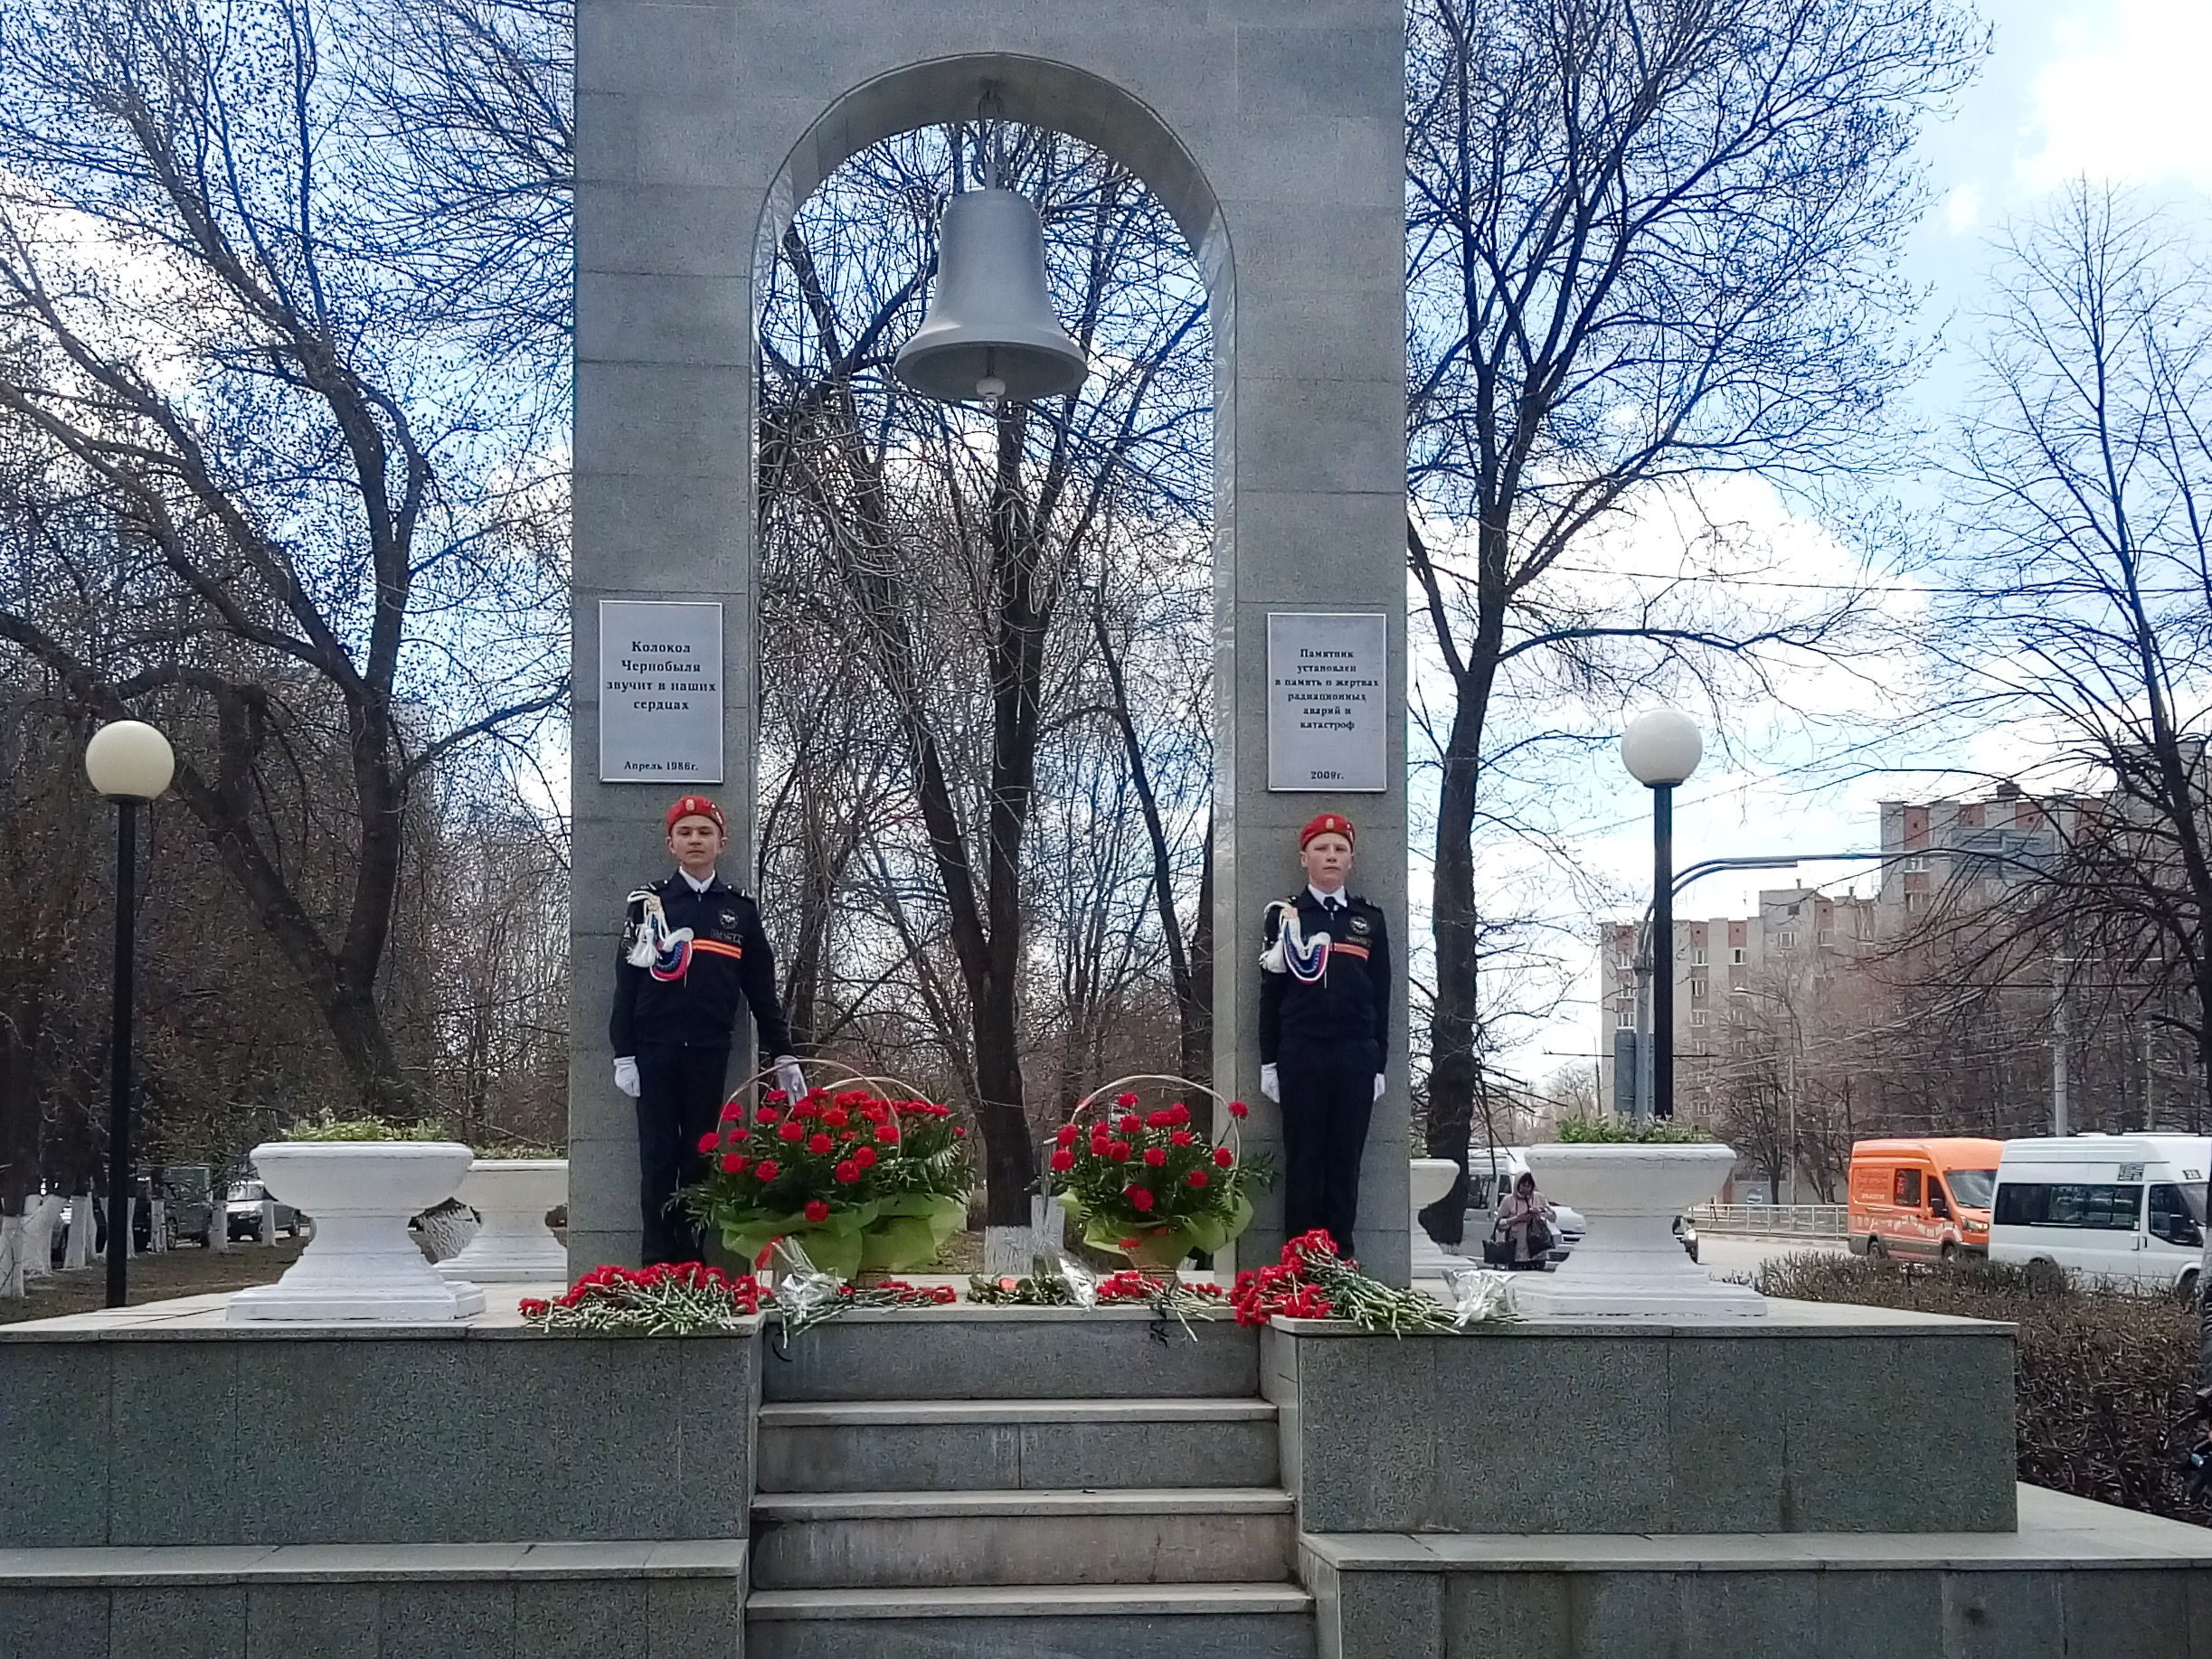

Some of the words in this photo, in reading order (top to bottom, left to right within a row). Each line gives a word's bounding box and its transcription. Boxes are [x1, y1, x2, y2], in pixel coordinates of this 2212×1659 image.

[631, 641, 691, 654] Колокол
[1300, 648, 1355, 658] Памятник
[621, 660, 701, 674] Чернобыля
[1297, 665, 1357, 674] установлен
[606, 681, 653, 693] звучит
[658, 682, 666, 691] в
[671, 682, 716, 692] наших
[1285, 679, 1322, 687] память
[1336, 680, 1379, 688] жертвах
[1288, 693, 1366, 702] радиационных
[633, 701, 689, 712] сердцах
[1303, 706, 1341, 715] аварий
[1300, 721, 1355, 731] катастроф
[624, 760, 663, 772] Апрель
[666, 761, 699, 771] 1986г.
[1310, 770, 1345, 779] 2009г.
